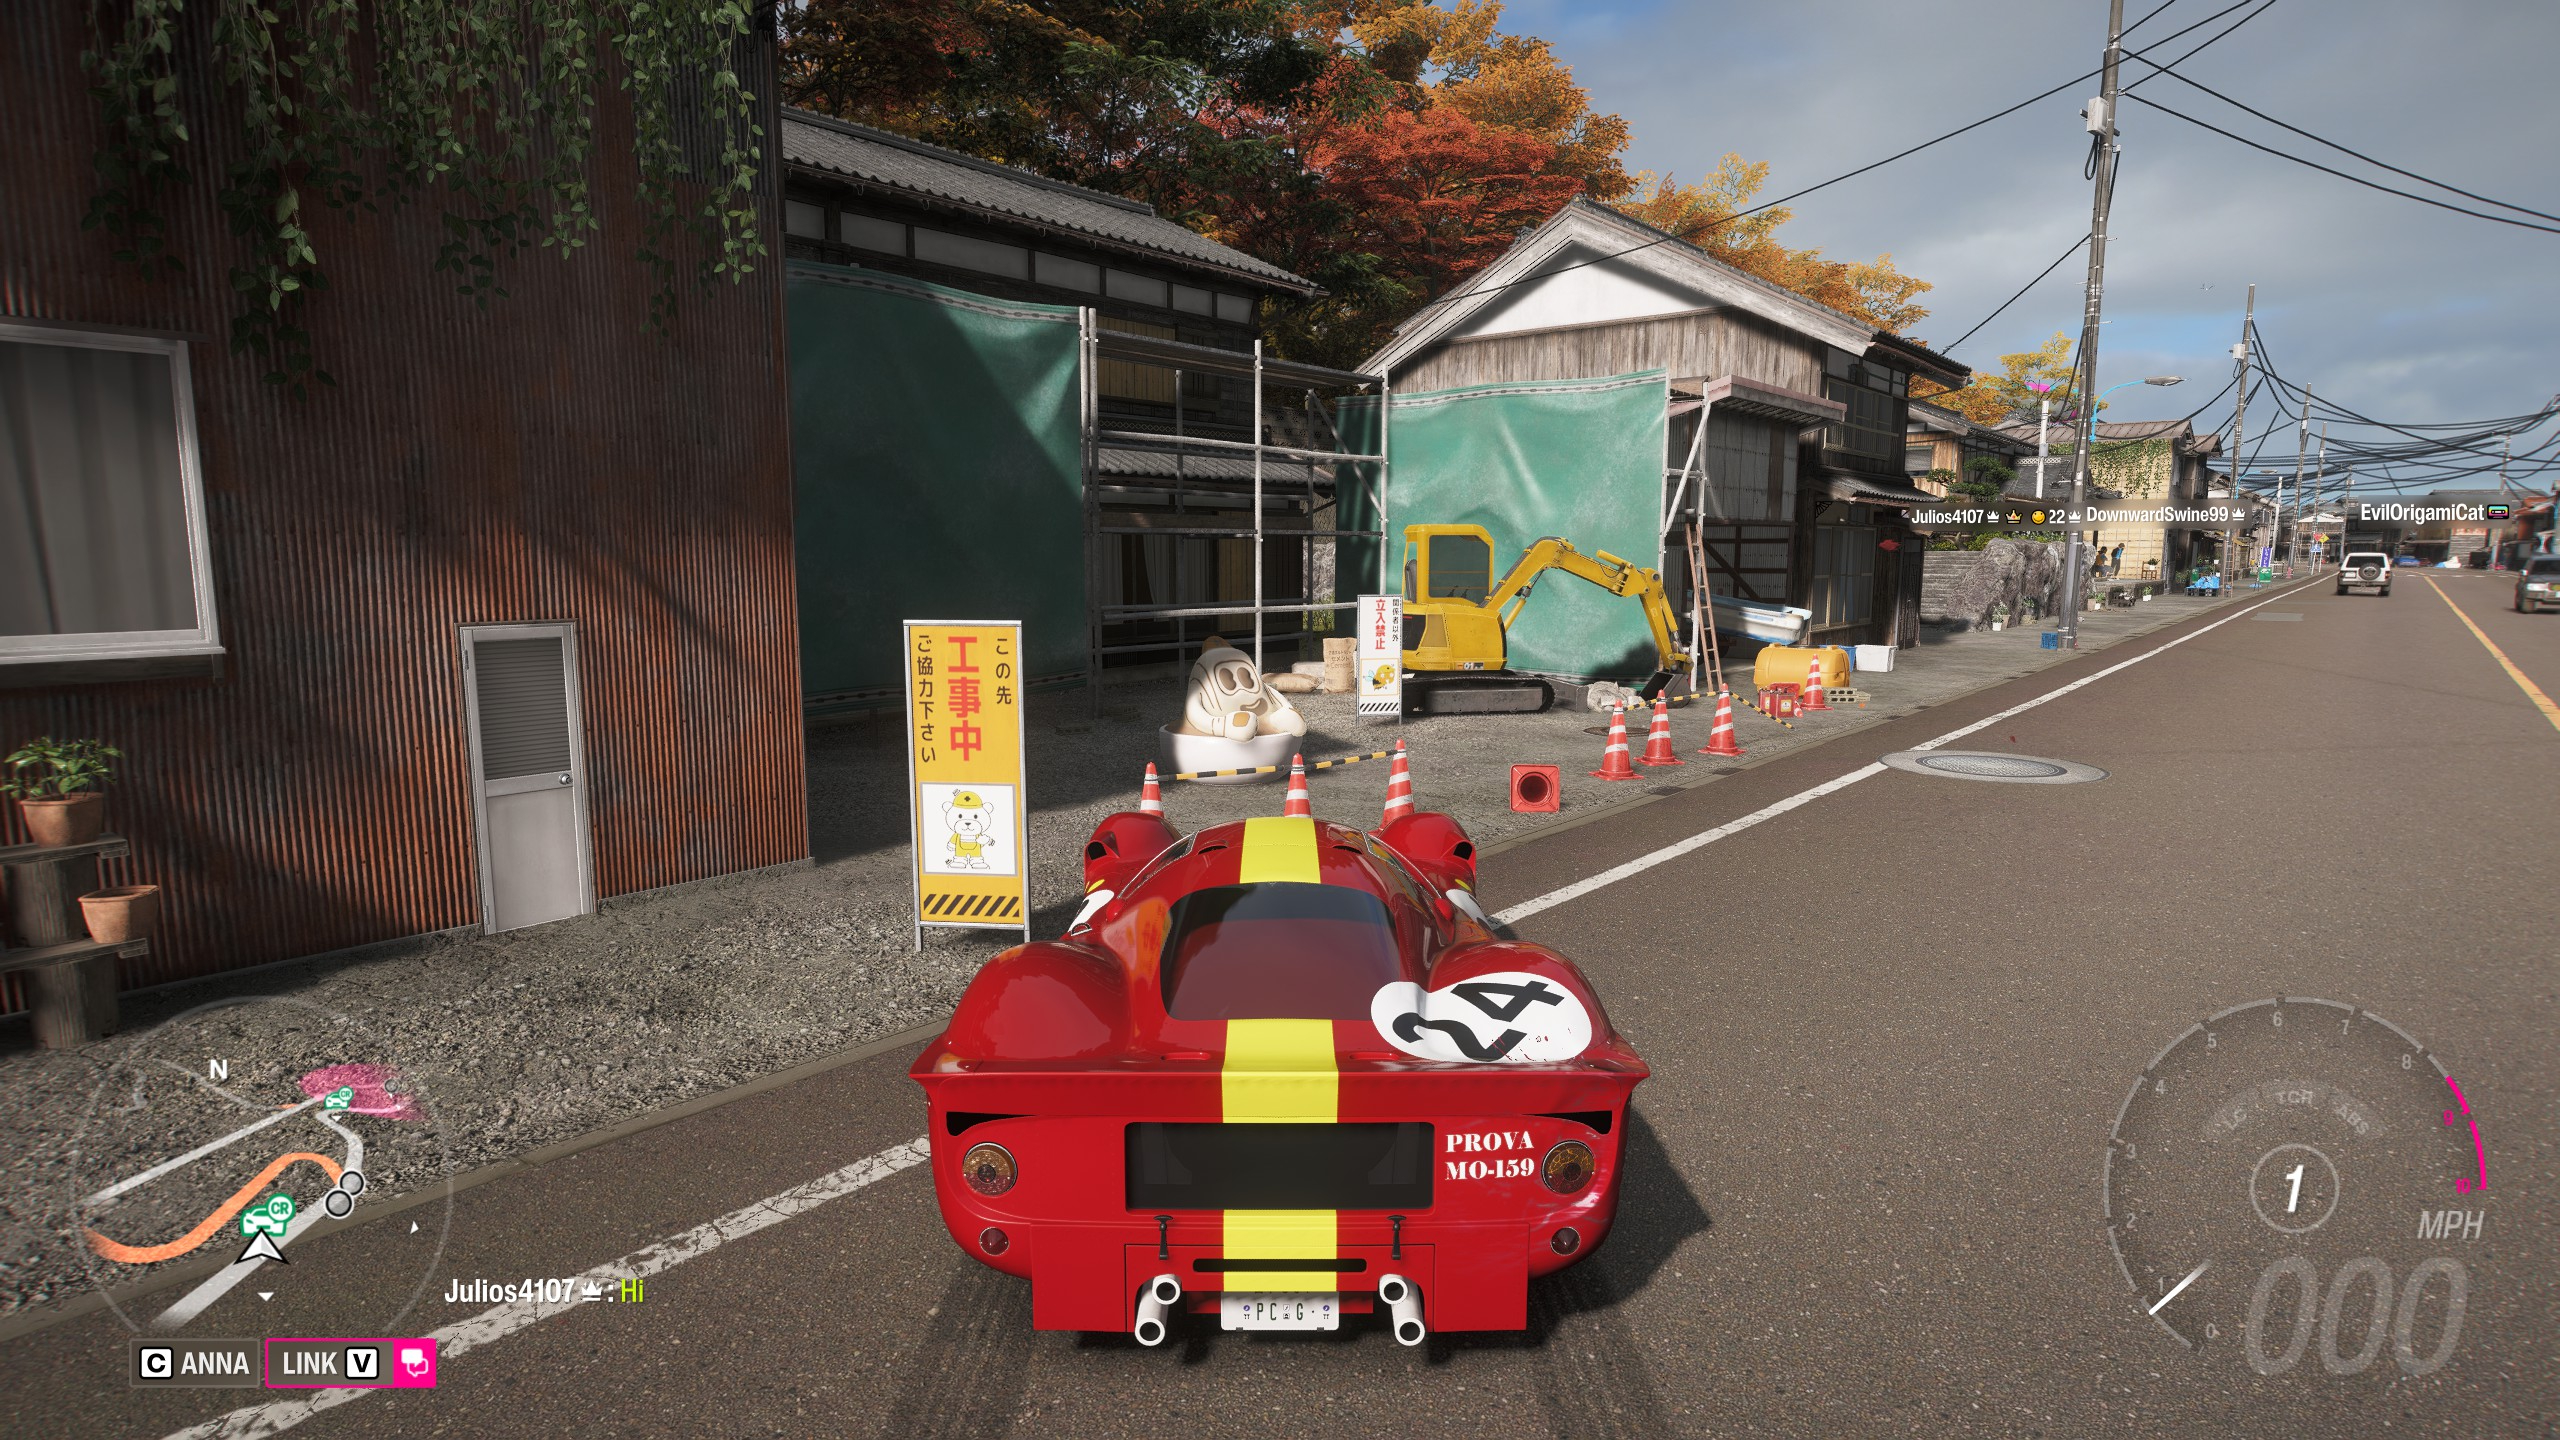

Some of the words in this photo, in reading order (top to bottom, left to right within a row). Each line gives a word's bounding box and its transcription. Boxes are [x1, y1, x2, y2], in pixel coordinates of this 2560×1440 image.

[1375, 599, 1386, 650] 立入禁止
[917, 634, 936, 763] ご協力下さい
[947, 636, 982, 762] 工事中
[995, 638, 1012, 705] この先
[1392, 980, 1565, 1062] 24
[1445, 1131, 1535, 1152] PROVA
[1445, 1158, 1535, 1180] MO-159
